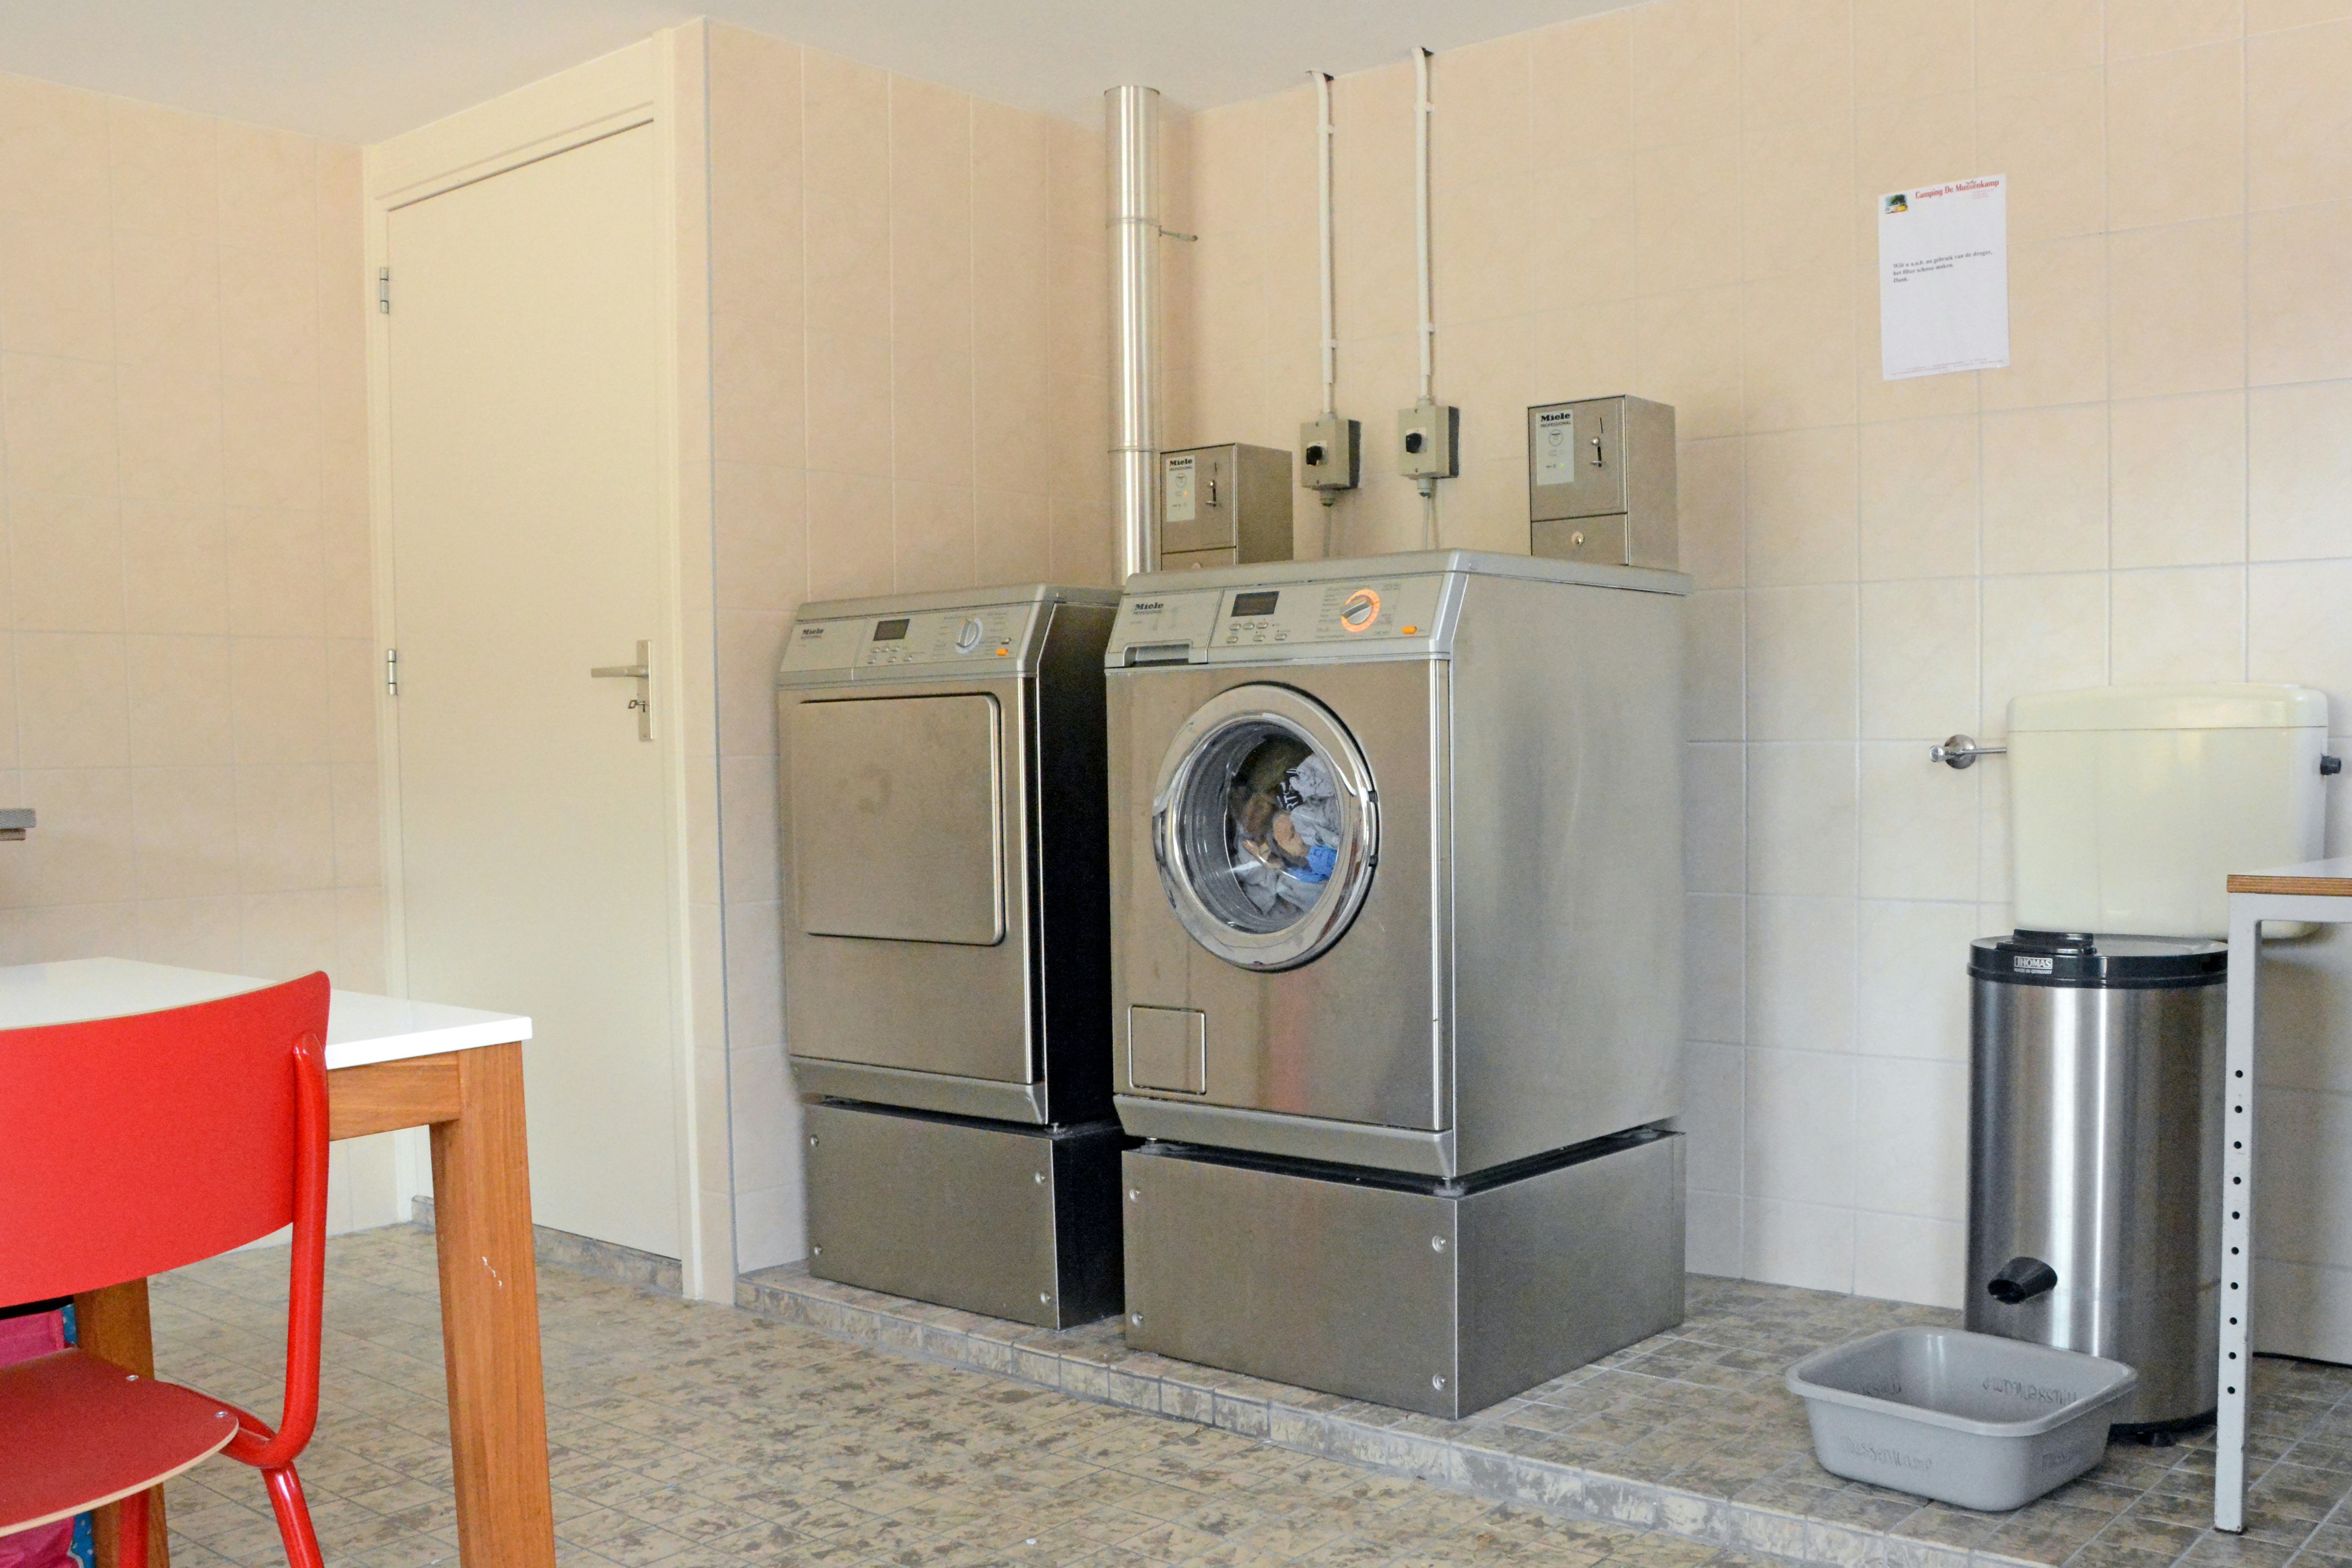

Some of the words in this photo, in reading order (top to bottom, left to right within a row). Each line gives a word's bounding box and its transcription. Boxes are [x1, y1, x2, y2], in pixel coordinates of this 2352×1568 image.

[1915, 188, 1943, 199] Camping
[1956, 180, 2000, 192] Mussenkamp
[1540, 413, 1571, 422] Miele
[2015, 957, 2051, 968] THOMAS
